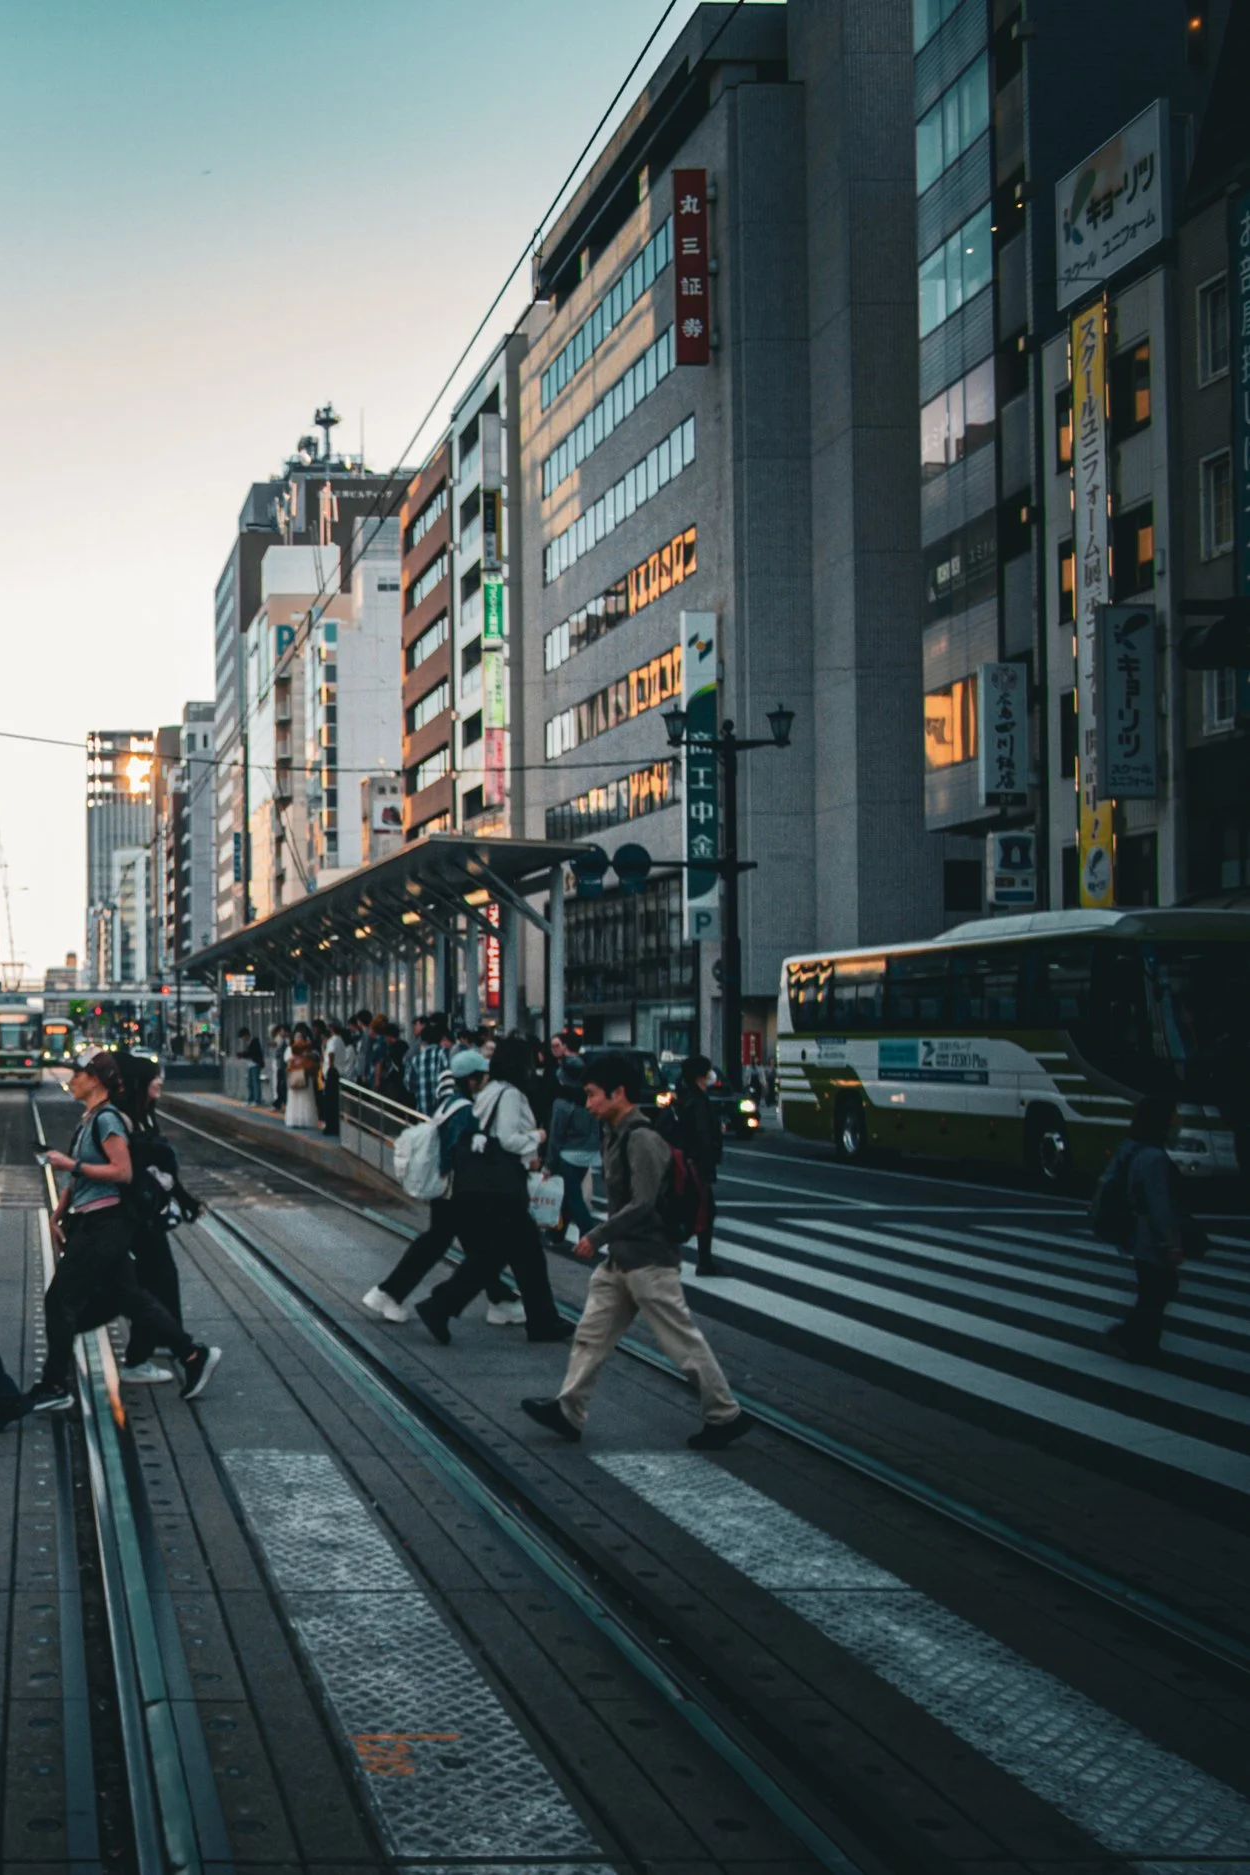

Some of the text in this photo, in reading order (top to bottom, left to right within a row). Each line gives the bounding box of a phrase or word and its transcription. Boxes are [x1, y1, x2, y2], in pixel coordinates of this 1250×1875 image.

[1085, 152, 1155, 231] キョーリツ
[680, 194, 704, 339] 丸三証券
[1116, 653, 1142, 759] キョーリツ
[695, 910, 713, 935] P
